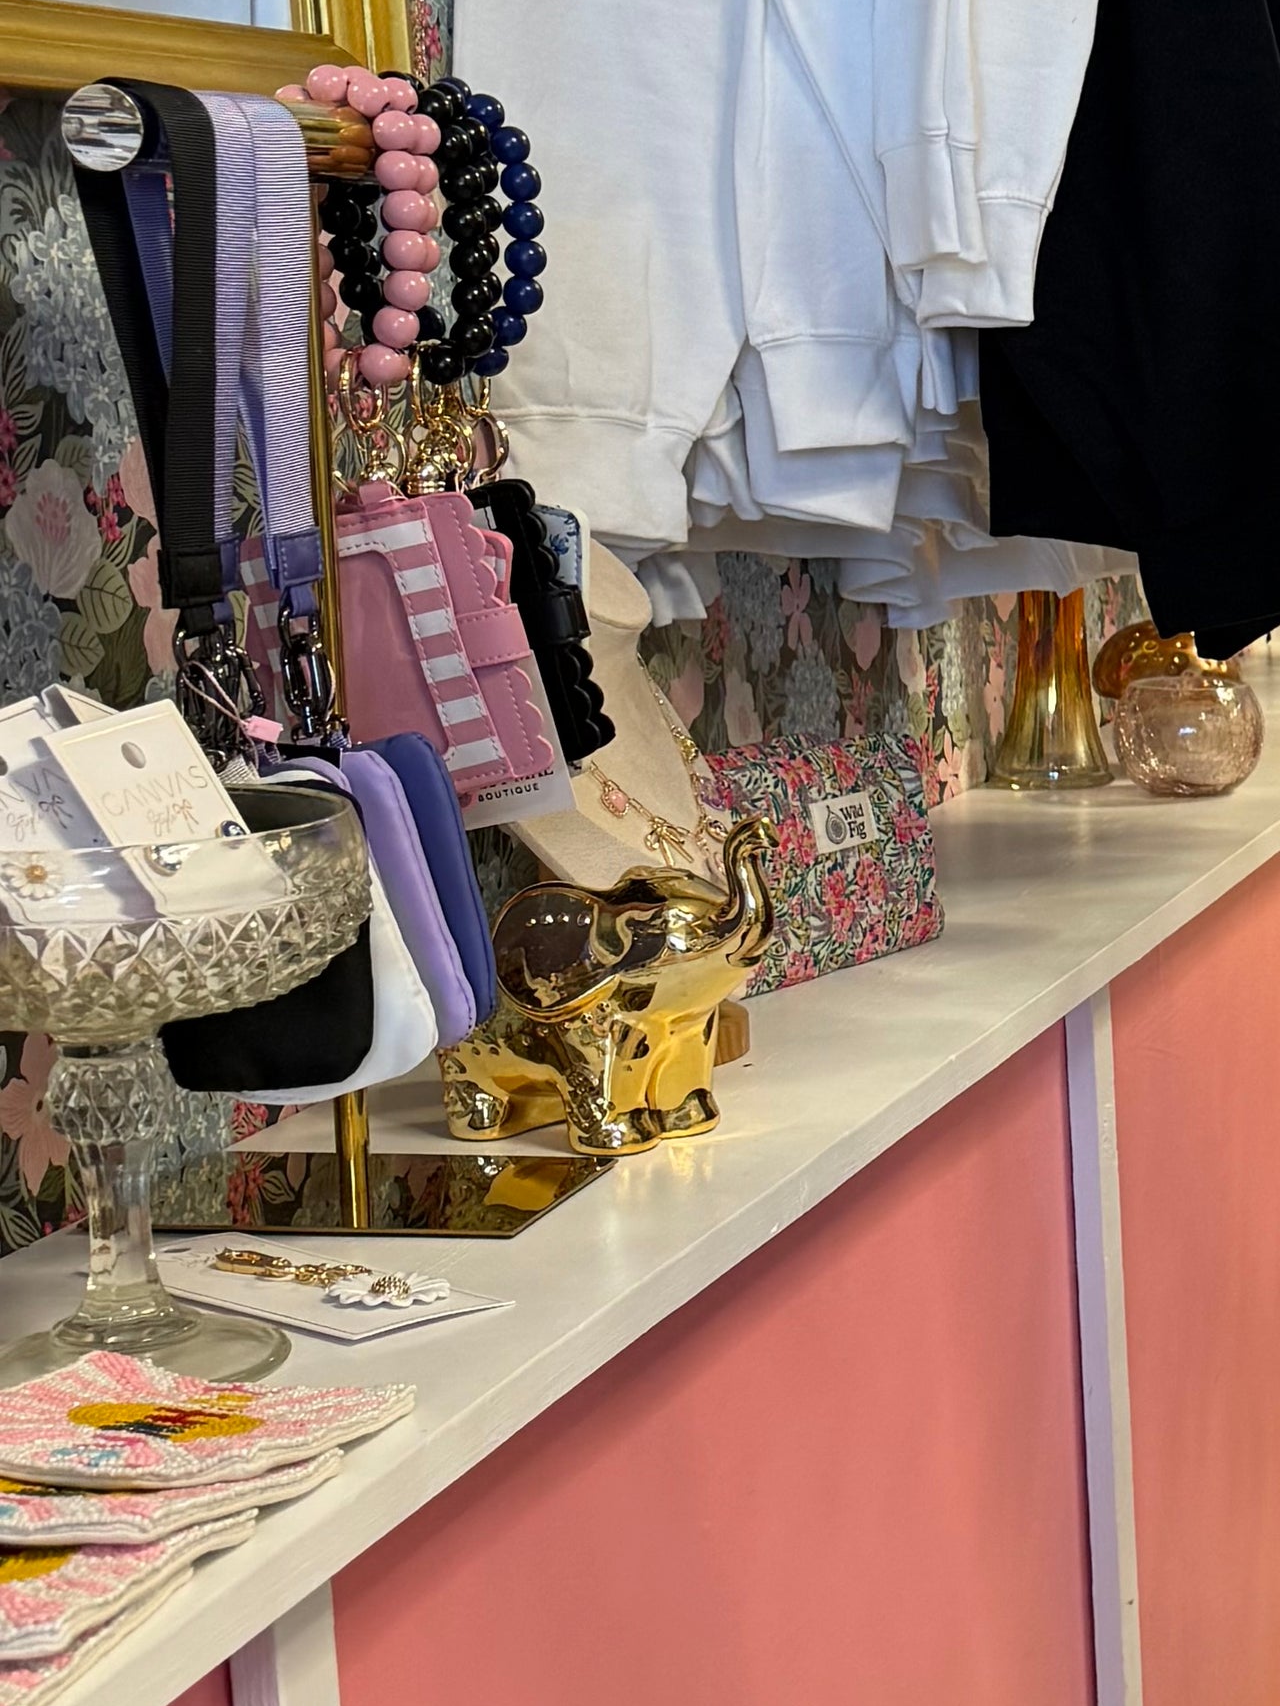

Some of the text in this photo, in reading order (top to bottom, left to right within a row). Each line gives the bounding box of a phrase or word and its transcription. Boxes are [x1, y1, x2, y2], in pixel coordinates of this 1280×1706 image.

[101, 765, 209, 816] CANVAS
[477, 782, 541, 803] BOUTIQUE
[839, 802, 865, 821] Wild
[847, 820, 867, 840] Fig
